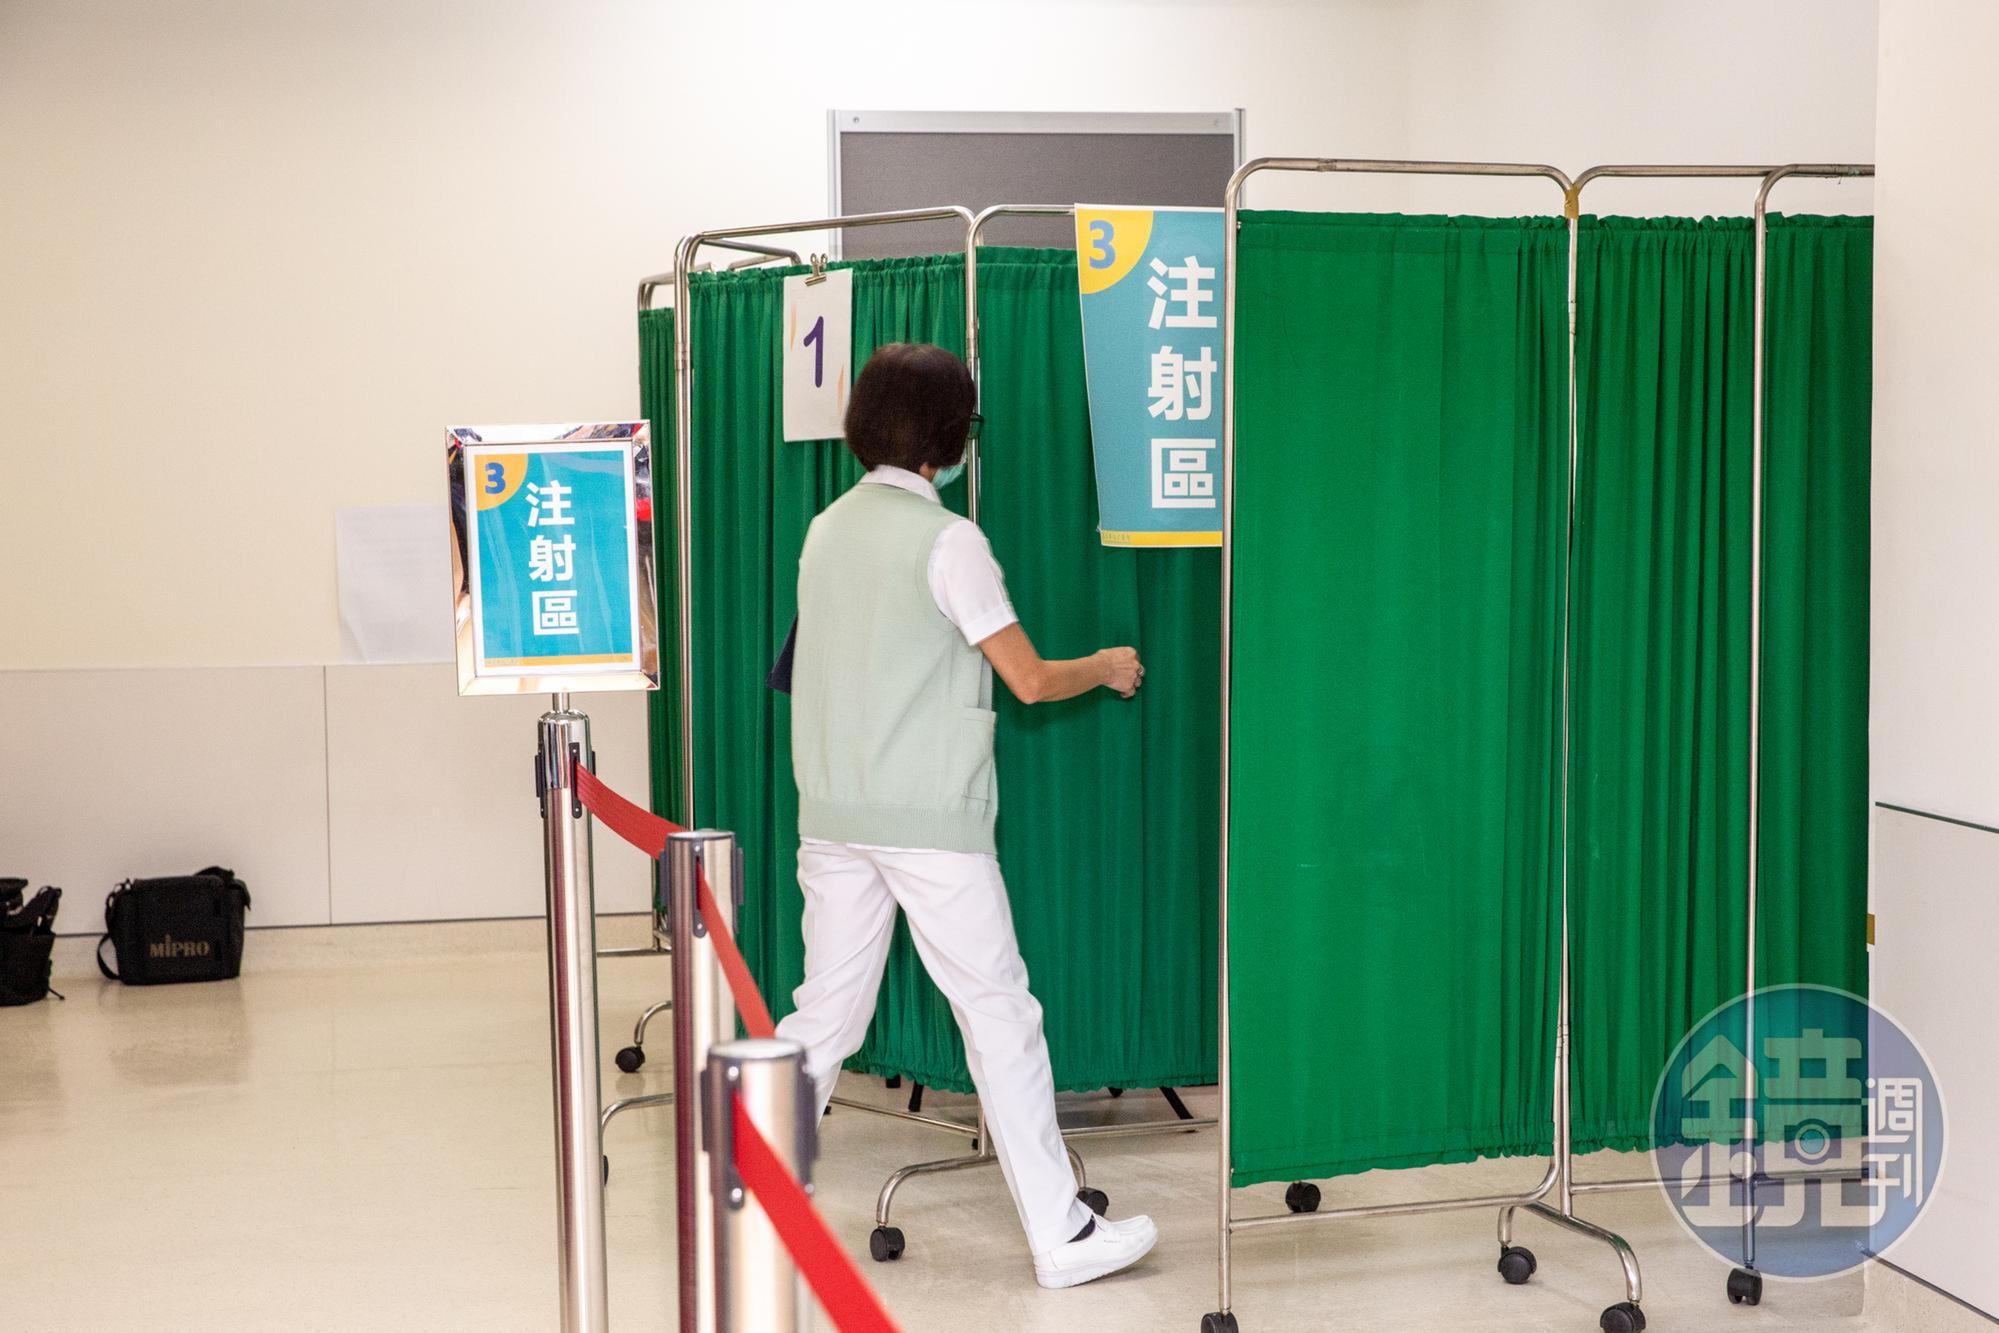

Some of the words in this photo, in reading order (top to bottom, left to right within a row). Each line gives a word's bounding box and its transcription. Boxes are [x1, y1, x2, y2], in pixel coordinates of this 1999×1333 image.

[1088, 219, 1116, 270] 3
[803, 315, 824, 388] 1
[1147, 255, 1218, 509] 注射區
[484, 462, 506, 494] 3
[525, 479, 580, 636] 注射區
